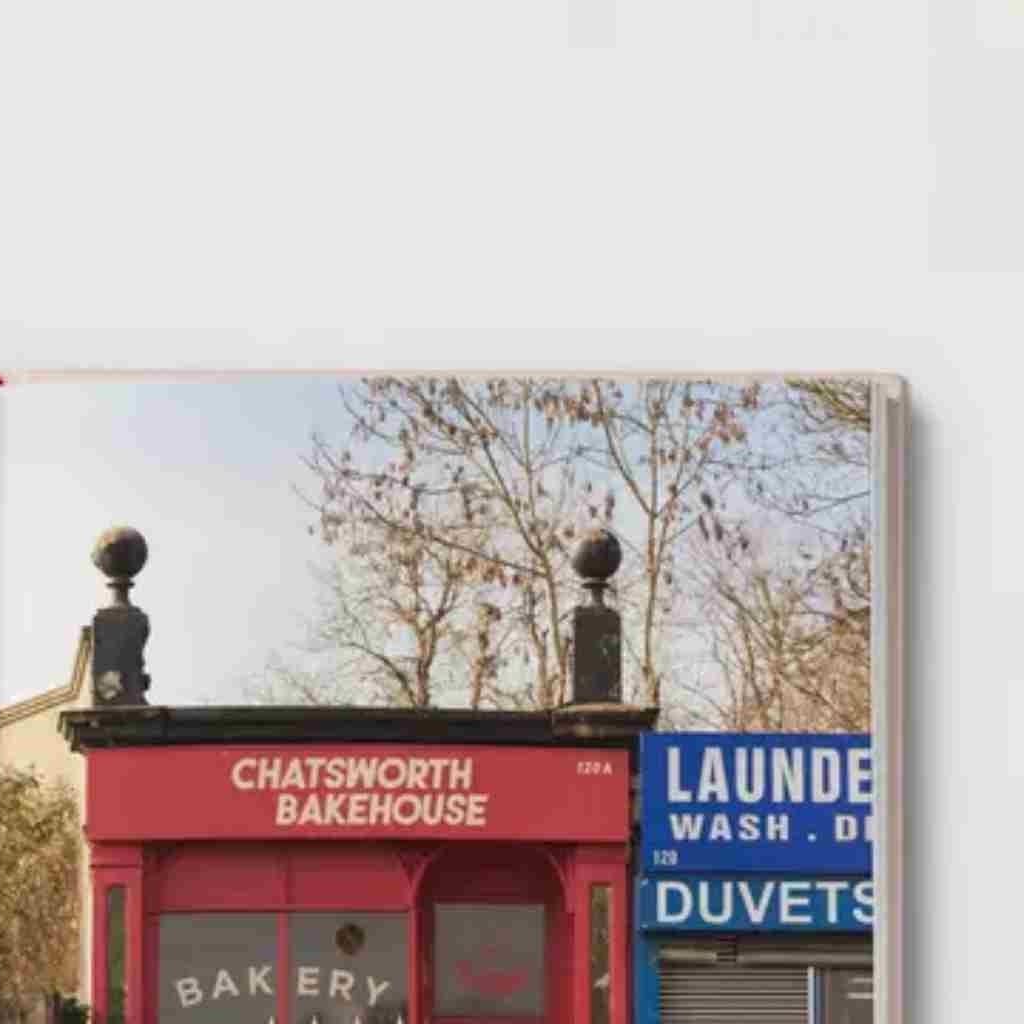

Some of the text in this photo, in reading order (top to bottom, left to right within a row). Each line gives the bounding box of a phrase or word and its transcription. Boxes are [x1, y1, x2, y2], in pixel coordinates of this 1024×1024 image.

[231, 757, 473, 790] CHATSWORTH
[667, 747, 873, 803] LAUNDE
[276, 793, 489, 826] BAKEHOUSE
[669, 813, 790, 841] WASH
[656, 881, 877, 924] DUVETS
[175, 965, 390, 1008] BAKERY
